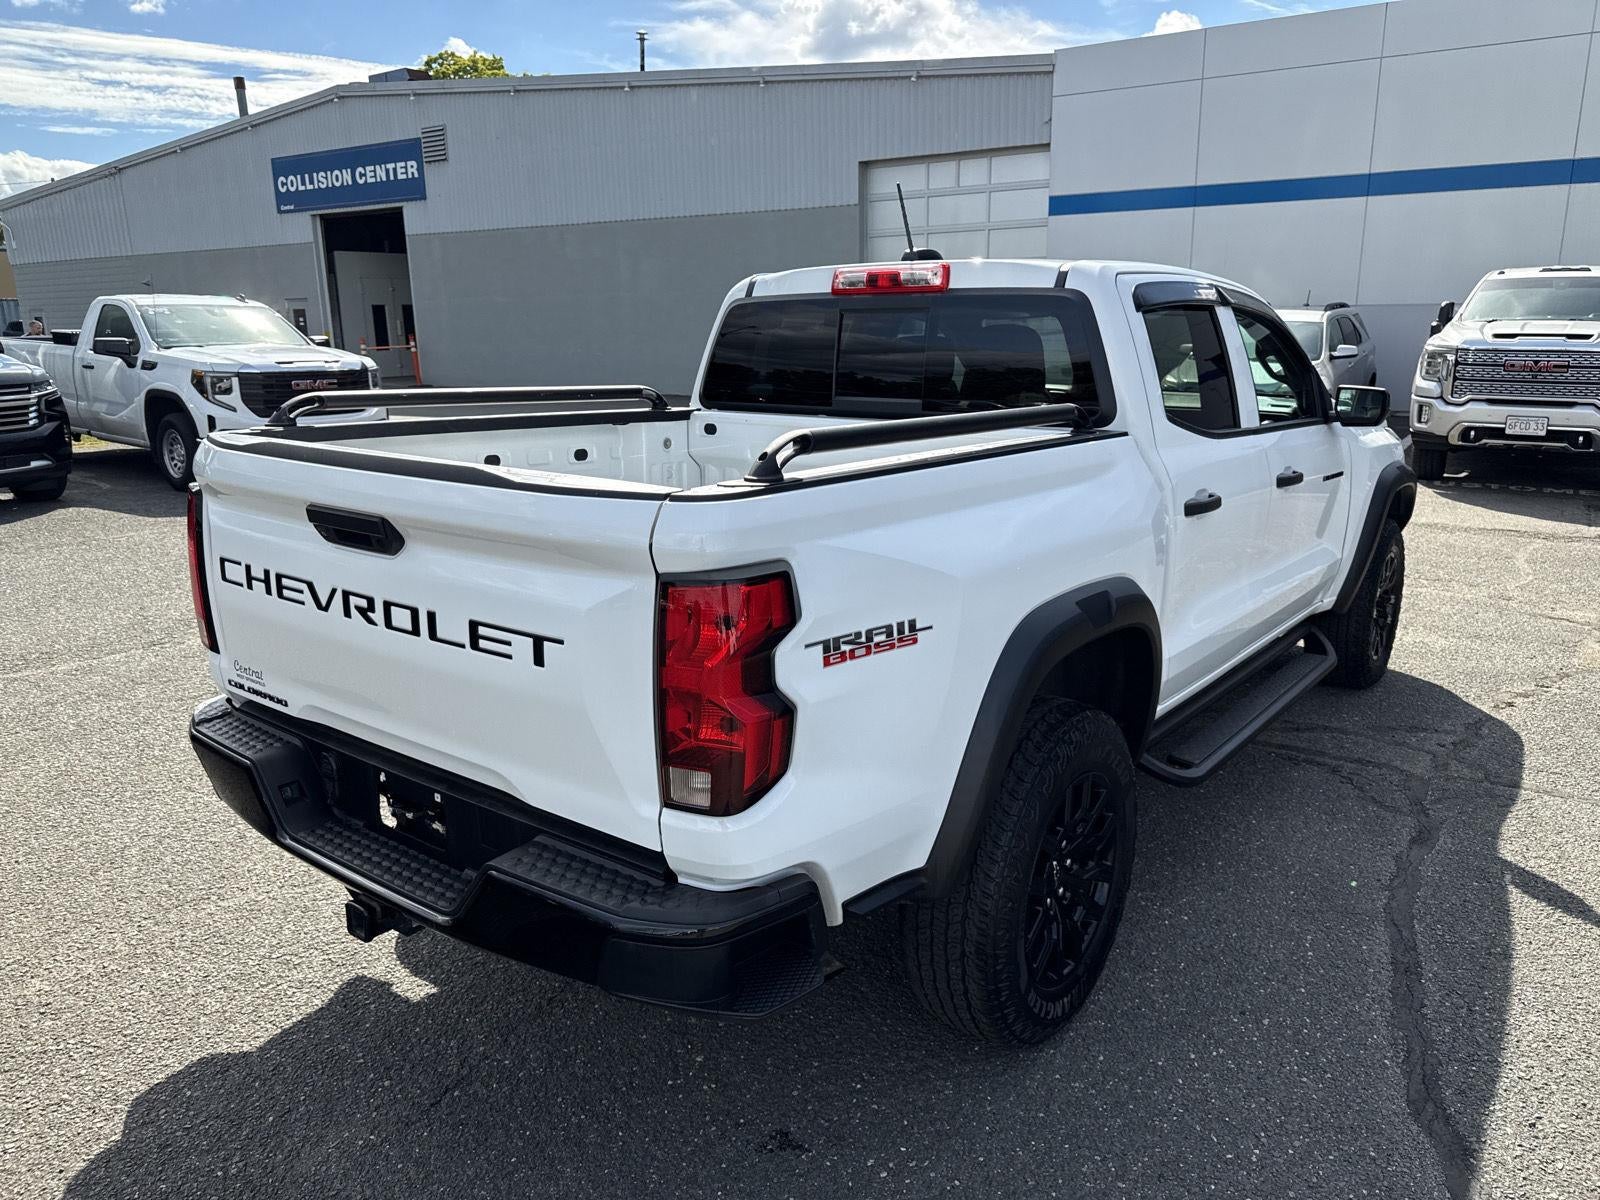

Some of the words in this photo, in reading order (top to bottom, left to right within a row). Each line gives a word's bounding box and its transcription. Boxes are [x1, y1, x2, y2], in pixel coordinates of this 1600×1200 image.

[277, 168, 352, 193] COLLISION
[355, 160, 419, 184] CENTER
[1505, 361, 1569, 372] GMC
[291, 378, 338, 391] GMC
[219, 556, 565, 668] CHEVROLET
[804, 618, 933, 655] TRAIL
[823, 633, 919, 669] BOSS
[234, 659, 264, 681] Central
[227, 679, 289, 708] COLORADO
